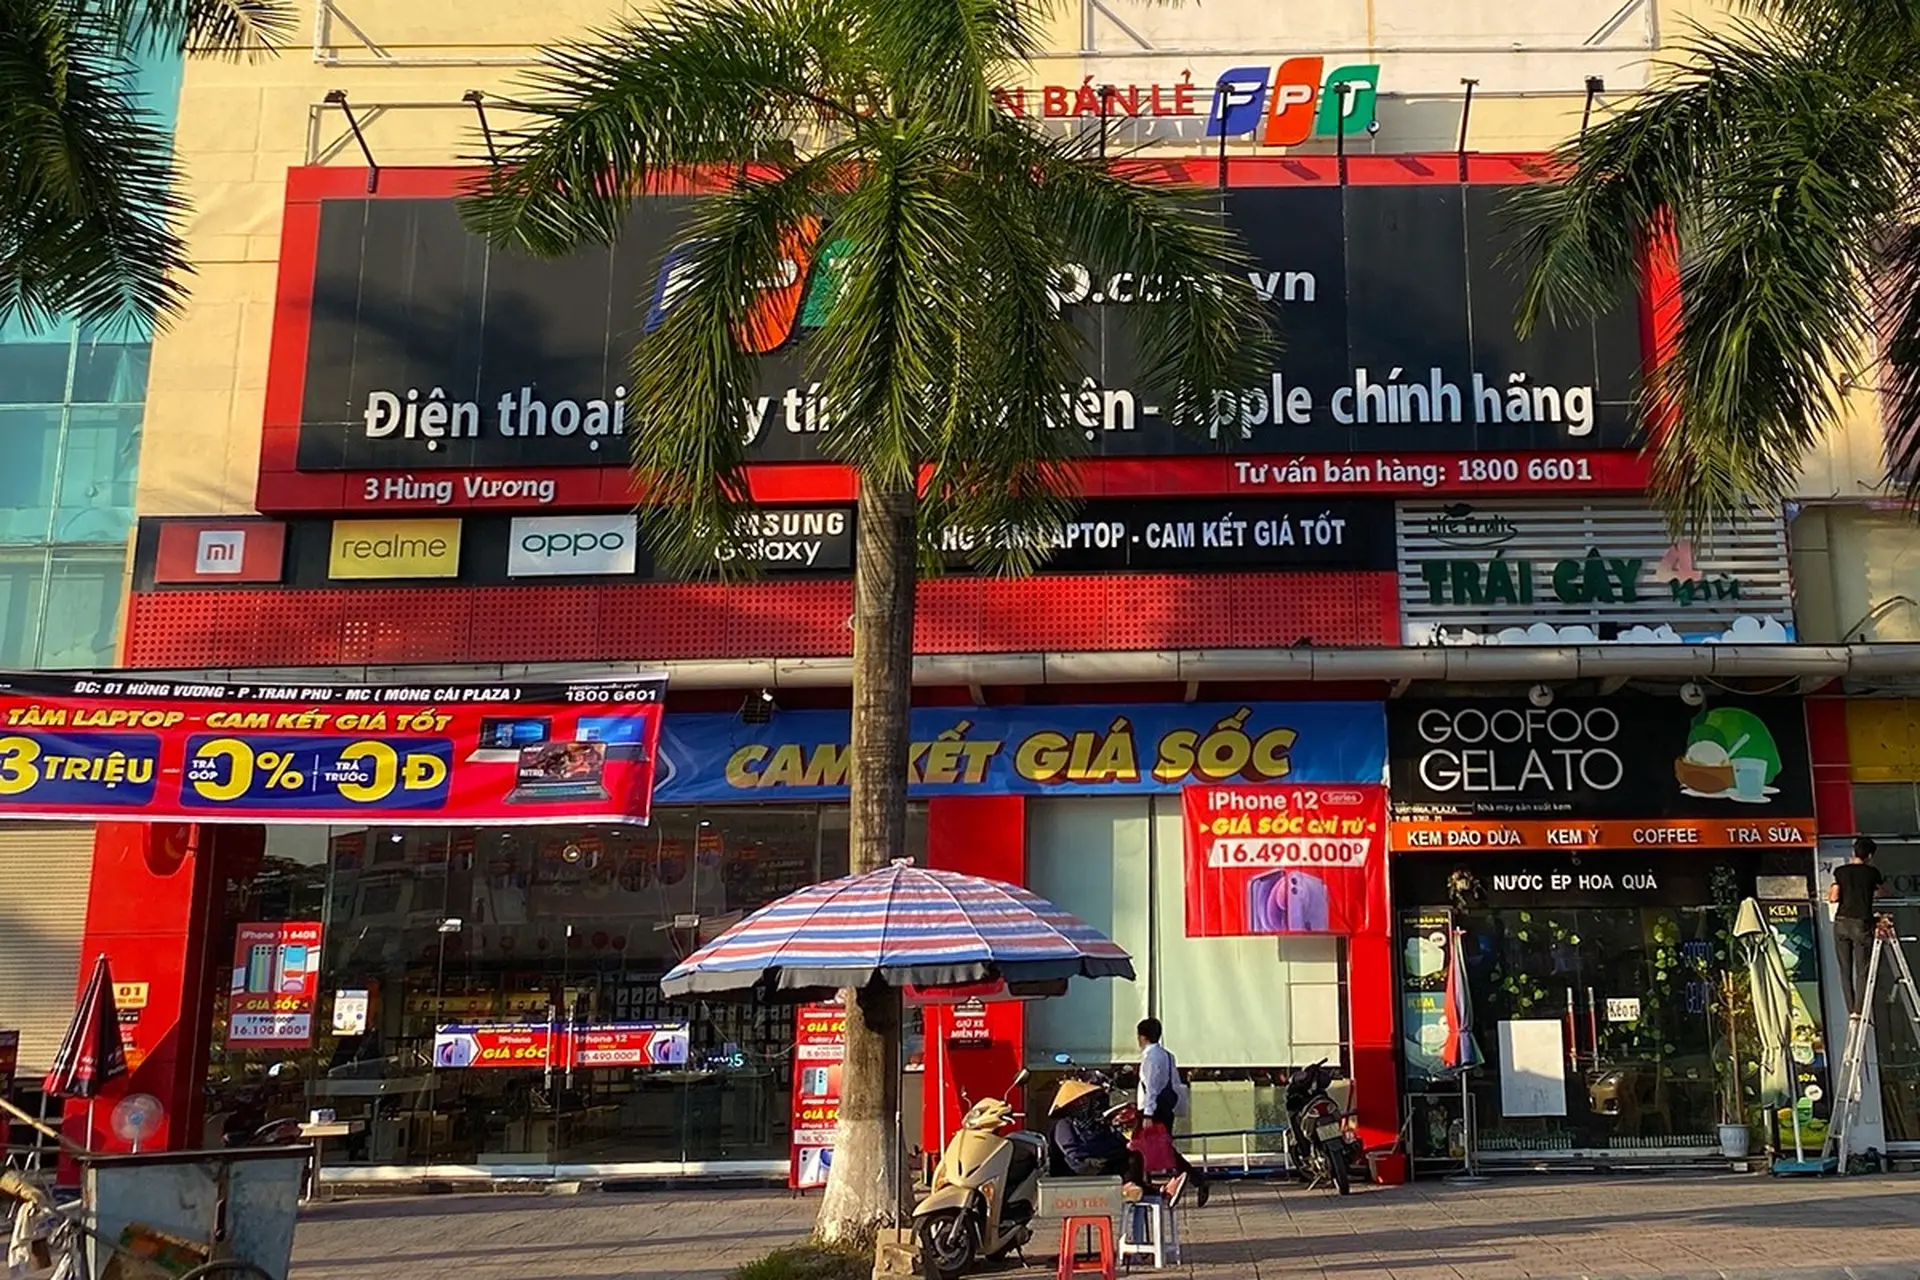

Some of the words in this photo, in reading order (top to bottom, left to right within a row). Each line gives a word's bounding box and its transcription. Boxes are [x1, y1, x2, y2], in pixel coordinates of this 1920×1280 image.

[1044, 74, 1139, 117] BÁN
[1151, 68, 1195, 116] LẺ
[1331, 368, 1463, 425] chính
[1473, 373, 1594, 437] hãng
[364, 386, 480, 451] Điện
[497, 386, 625, 452] thoại
[1235, 461, 1268, 483] Tư
[1273, 457, 1317, 483] vấn
[1324, 459, 1371, 483] bán
[1376, 458, 1446, 487] hàng:
[1458, 459, 1518, 481] 1800
[1527, 458, 1592, 480] 6601
[364, 478, 378, 500] 3
[384, 474, 453, 505] Hùng
[463, 476, 556, 505] Vương
[1146, 522, 1195, 549] CAM
[1202, 511, 1247, 547] KẾT
[1254, 514, 1295, 546] GIÁ
[1300, 510, 1345, 545] TỐT
[342, 534, 447, 558] realme
[521, 531, 624, 556] oppo
[1421, 549, 1532, 606] TRÁI
[1552, 546, 1643, 605] CÂY
[74, 681, 100, 694] ĐC:
[104, 683, 123, 694] 01
[126, 682, 170, 696] HÙNG
[345, 689, 371, 701] MC
[433, 687, 460, 701] CÁI
[462, 688, 510, 701] PLAZA
[565, 690, 609, 702] 1800
[613, 690, 656, 702] 6601
[8, 705, 66, 726] TÂM
[72, 710, 185, 727] LAPTOP
[205, 711, 271, 729] CAM
[275, 708, 332, 730] KẾT
[335, 711, 387, 731] GIÁ
[396, 708, 452, 731] TỐT
[1418, 708, 1620, 744] GOOFOO
[908, 719, 1004, 786] KẾT
[1012, 717, 1137, 784] GIÁ
[1151, 706, 1297, 780] SỐC
[43, 752, 154, 788] TRIỆU
[188, 770, 219, 780] GÓP
[1419, 747, 1624, 792] GELATO
[1208, 792, 1287, 810] iPhone
[1292, 791, 1319, 809] 12
[1211, 814, 1252, 836] GIÁ
[1257, 811, 1304, 834] SỐC
[1342, 817, 1366, 834] TỪ
[1407, 830, 1442, 846] KEM
[1547, 829, 1582, 844] KEM
[1633, 828, 1698, 843] COFFEE
[1727, 824, 1762, 842] TRÀ
[1768, 822, 1802, 842] SỮA
[1493, 868, 1543, 891] NƯỚC
[1550, 868, 1571, 890] ÉP
[1578, 874, 1614, 889] HOA
[1769, 905, 1798, 916] KEM
[242, 931, 274, 940] iPhone
[246, 1000, 270, 1010] GIÁ
[615, 1034, 628, 1043] 12
[482, 1046, 510, 1059] GIÁ
